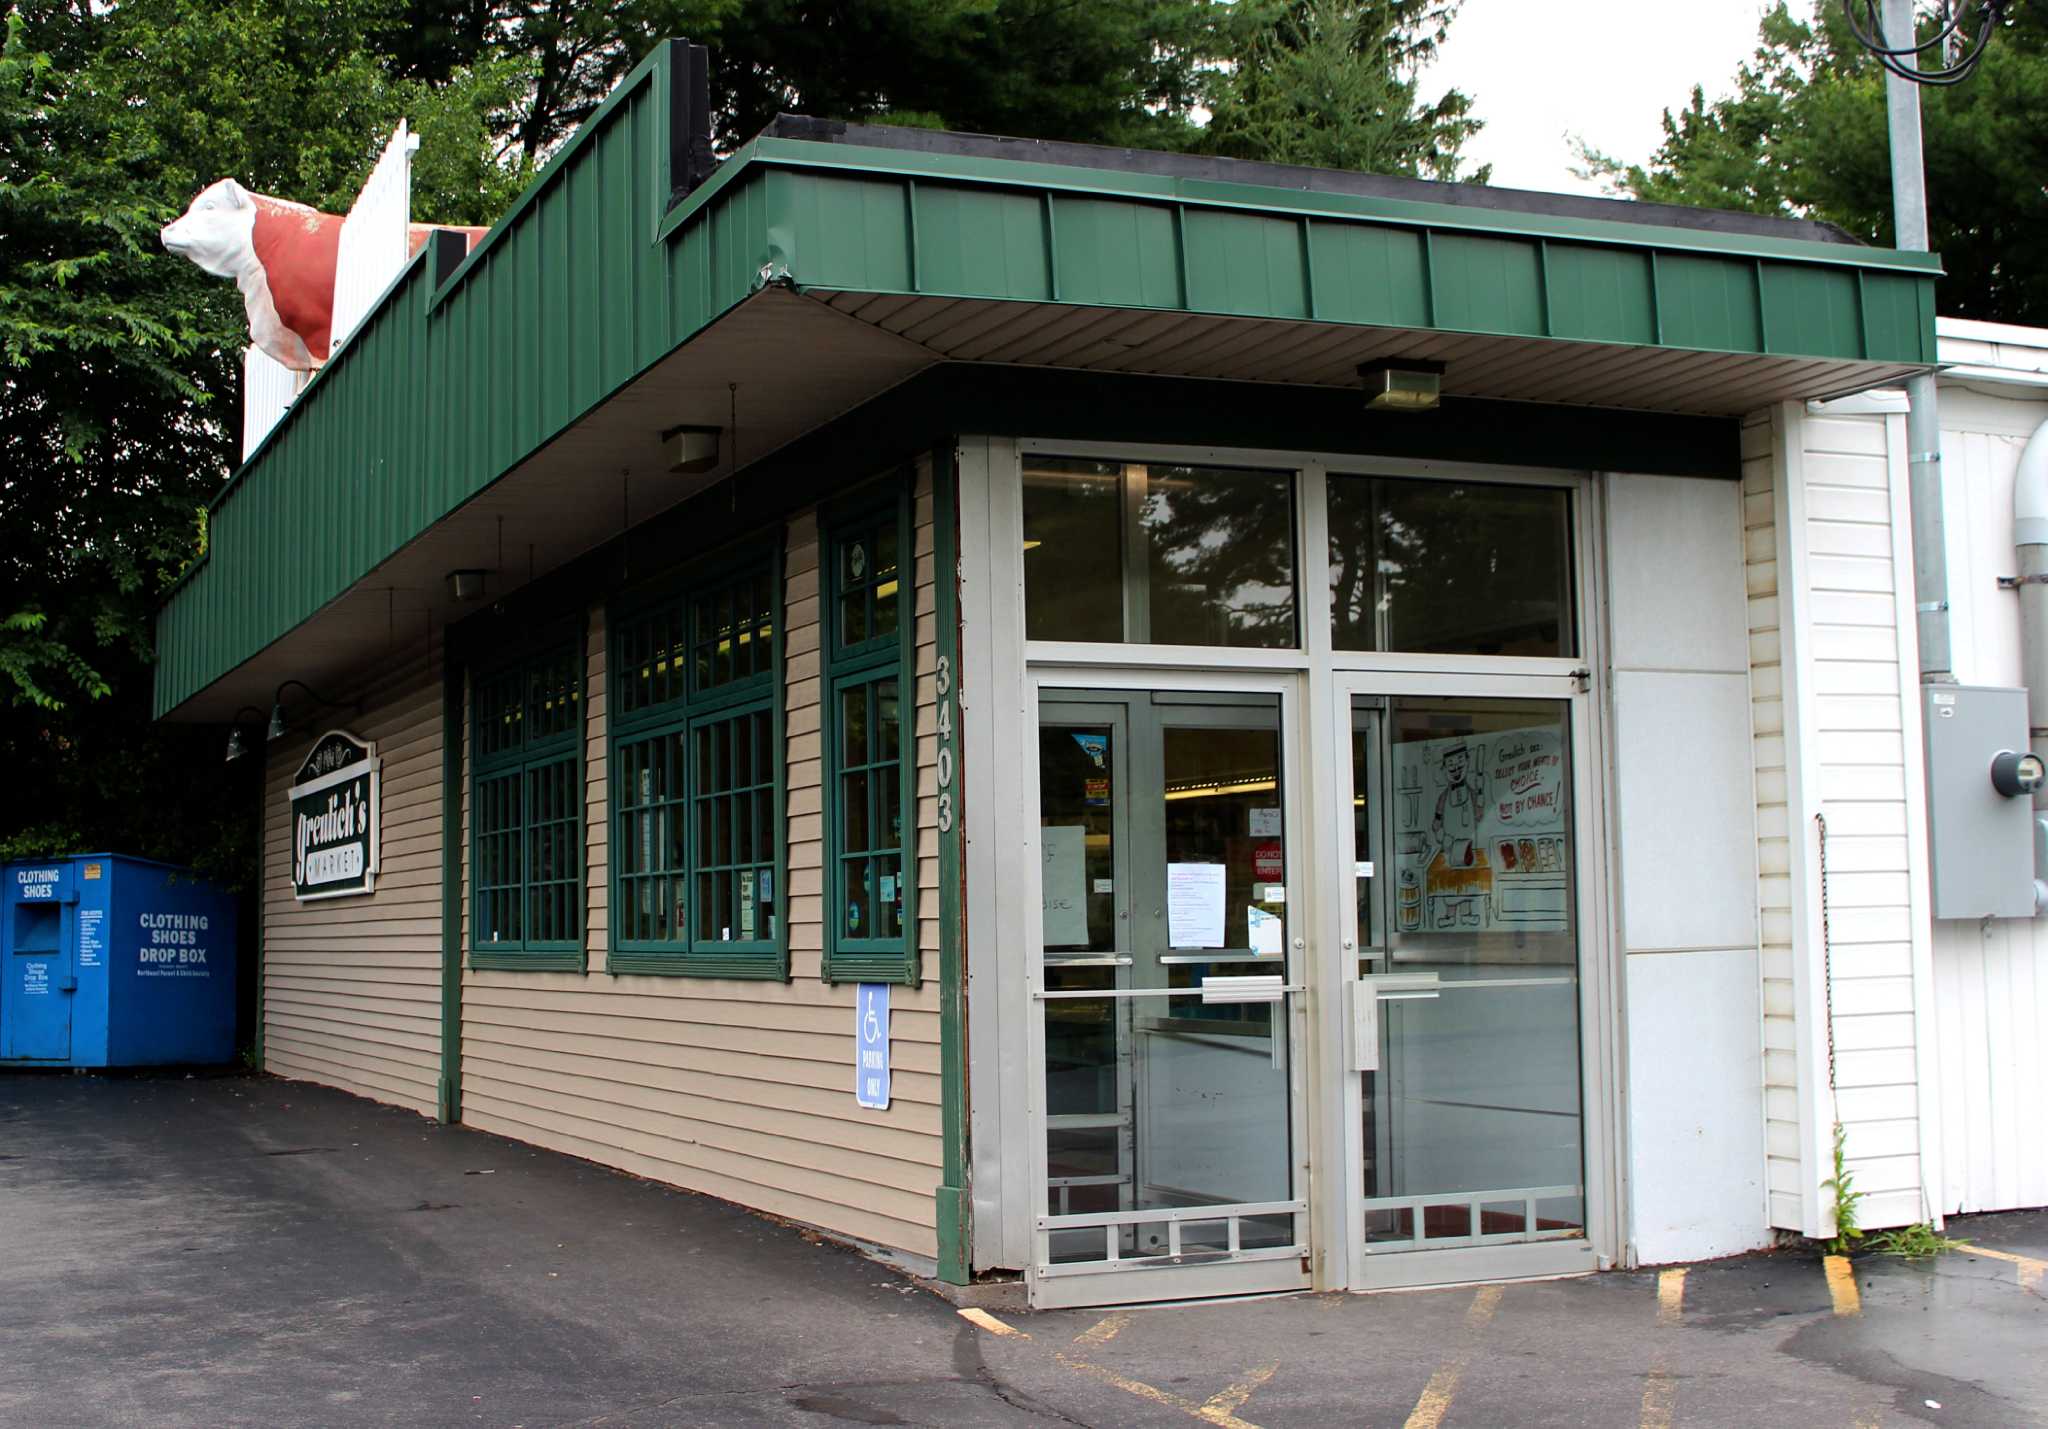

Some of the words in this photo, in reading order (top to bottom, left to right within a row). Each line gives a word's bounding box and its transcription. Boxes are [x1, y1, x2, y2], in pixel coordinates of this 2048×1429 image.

[937, 655, 953, 833] 3403
[1515, 799, 1525, 814] BY
[314, 849, 354, 877] MARKET
[17, 870, 59, 883] CLOTHING
[24, 884, 52, 898] SHOES
[139, 913, 209, 930] CLOTHING
[151, 929, 196, 945] SHOES
[139, 947, 176, 963] DROP
[179, 948, 207, 963] BOX
[862, 1049, 883, 1071] PARKING
[867, 1075, 881, 1097] ONLY
